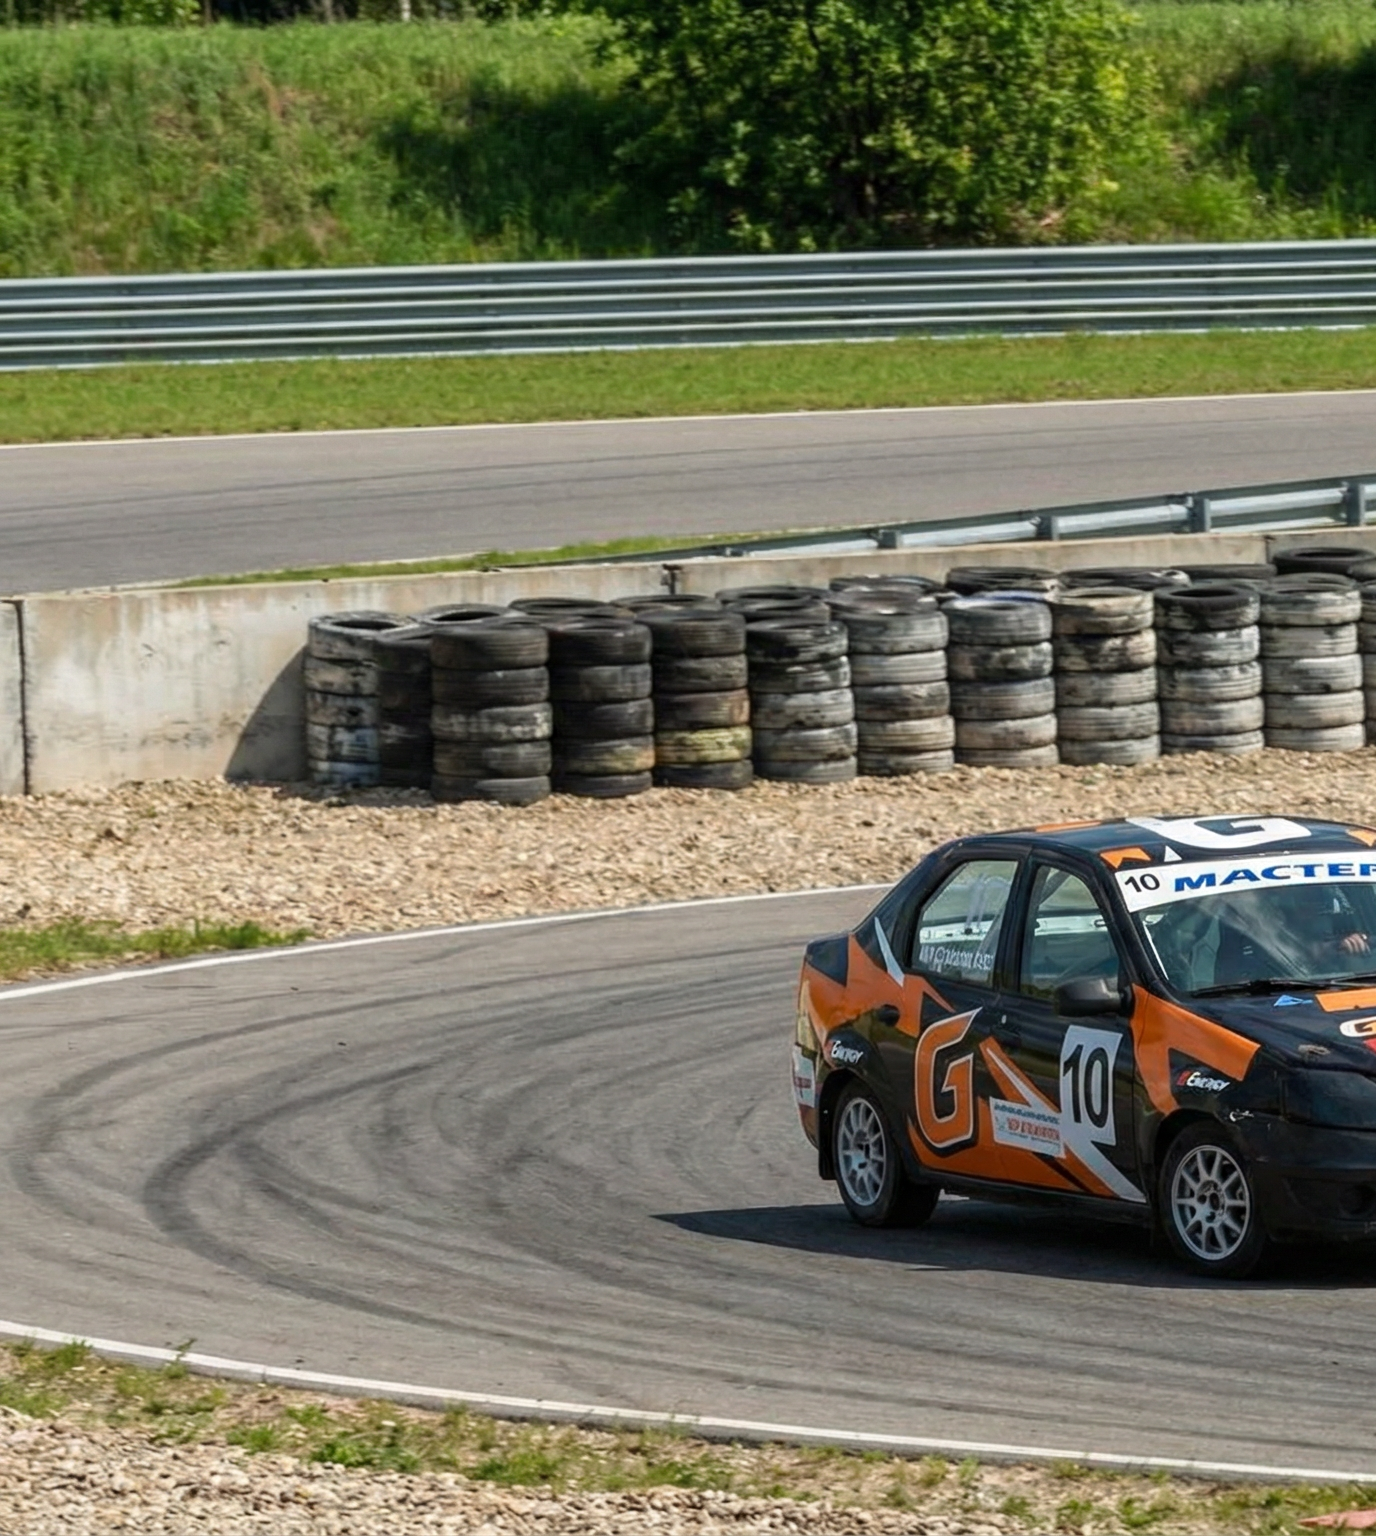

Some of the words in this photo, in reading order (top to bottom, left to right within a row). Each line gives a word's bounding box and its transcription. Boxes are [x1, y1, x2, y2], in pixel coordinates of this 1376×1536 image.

[1124, 873, 1160, 893] 10
[914, 1006, 983, 1148] G
[1063, 1043, 1109, 1128] 10
